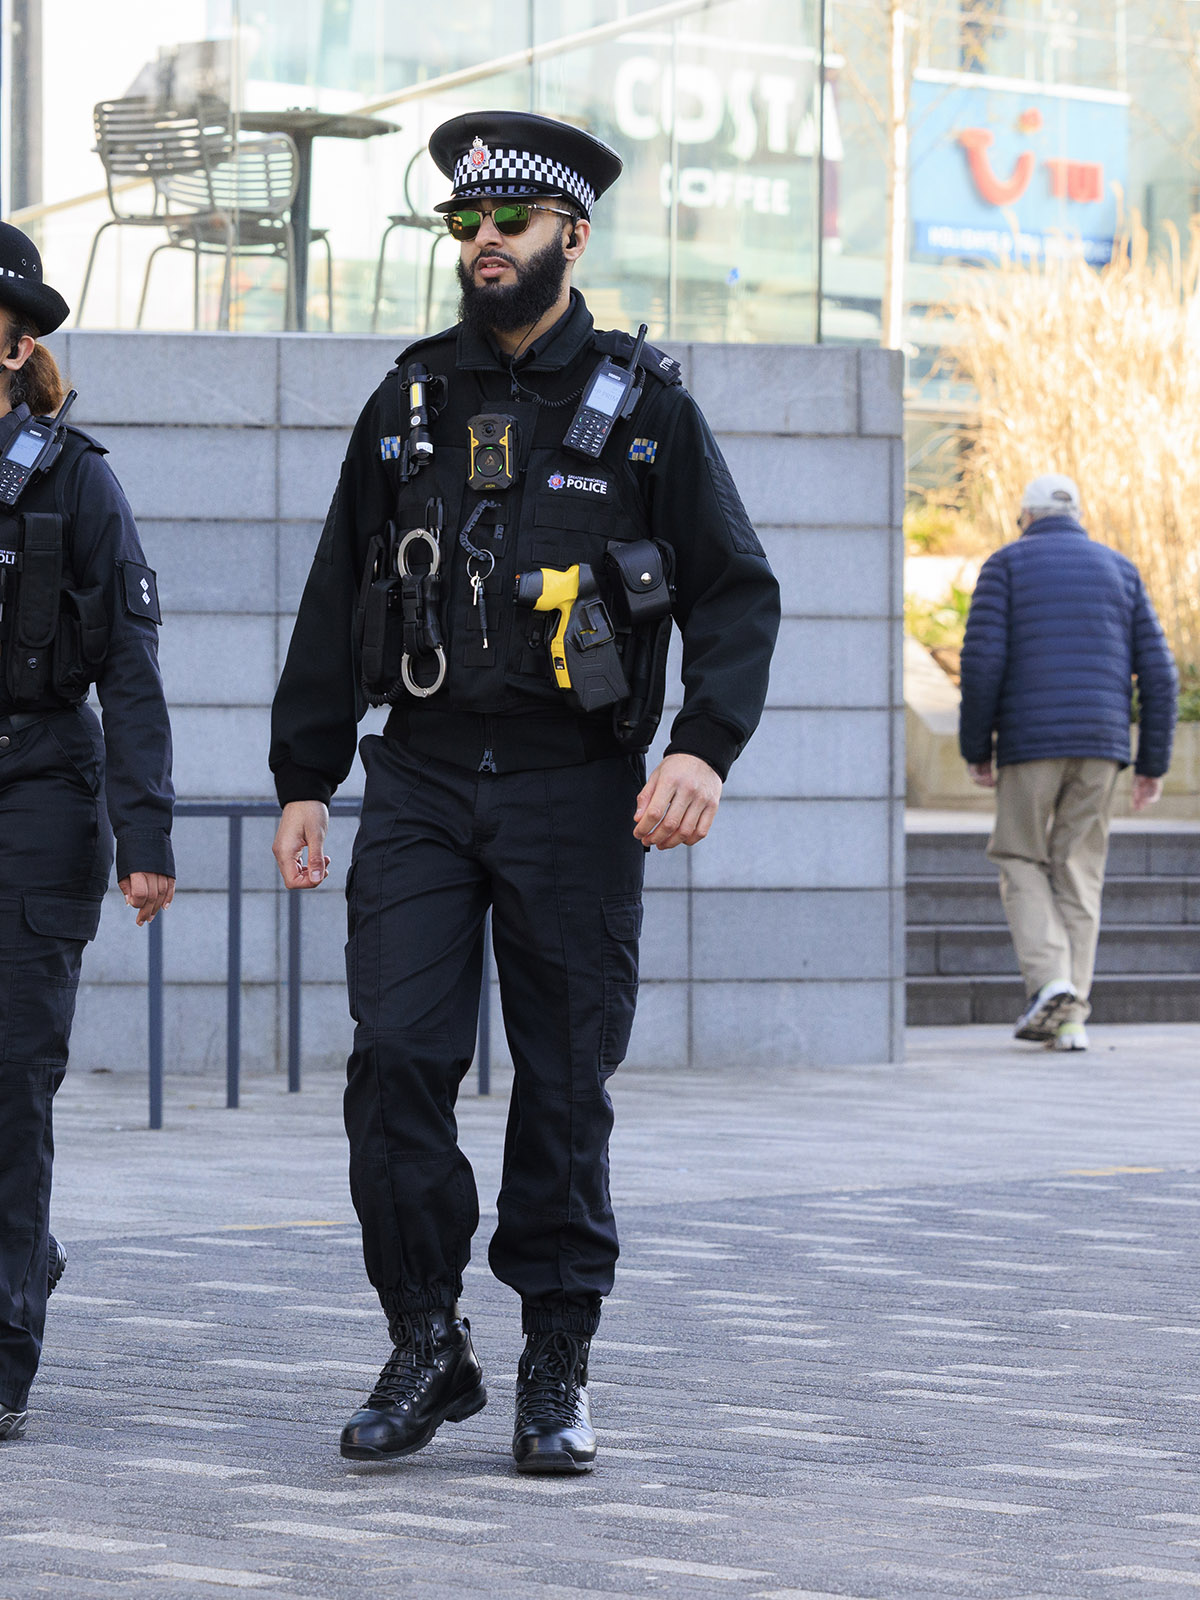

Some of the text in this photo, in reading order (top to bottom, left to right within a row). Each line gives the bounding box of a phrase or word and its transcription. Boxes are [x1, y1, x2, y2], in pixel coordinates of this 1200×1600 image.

[614, 55, 845, 162] COSTA
[659, 162, 791, 216] COFFEE
[566, 478, 608, 495] POLICE
